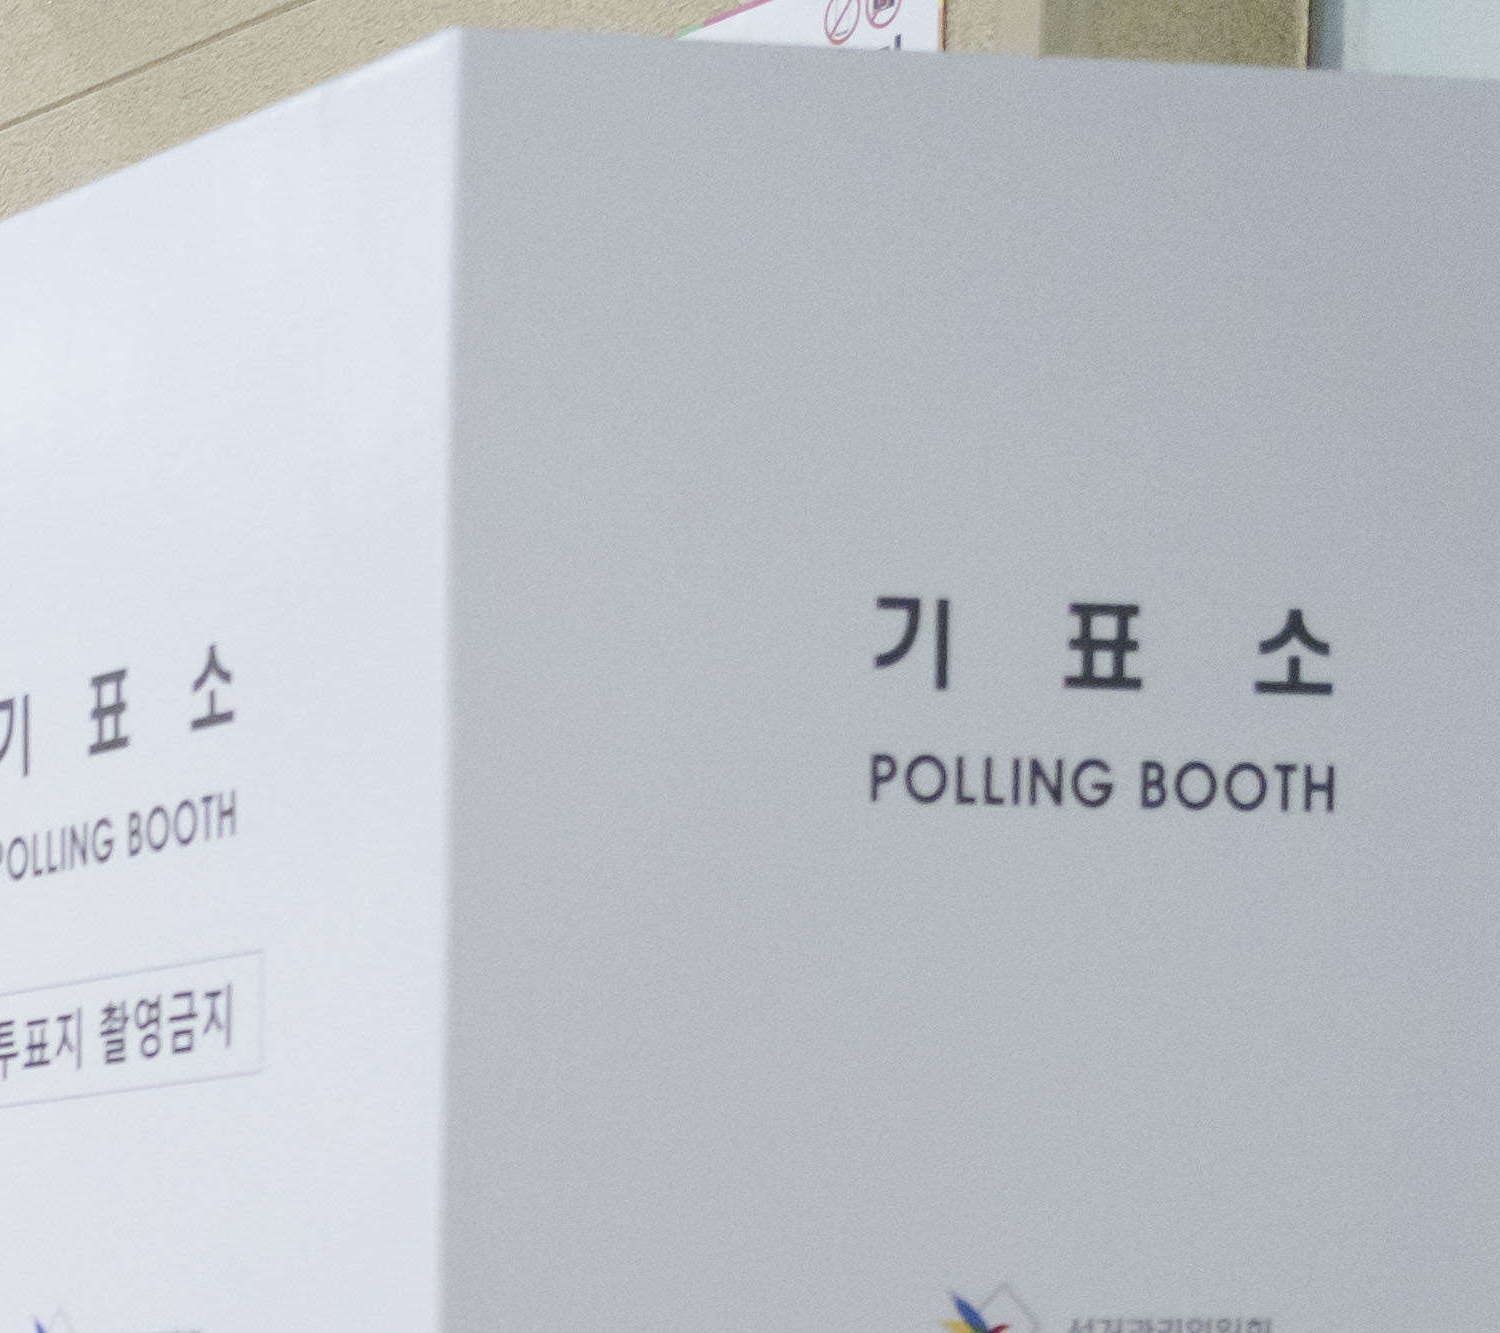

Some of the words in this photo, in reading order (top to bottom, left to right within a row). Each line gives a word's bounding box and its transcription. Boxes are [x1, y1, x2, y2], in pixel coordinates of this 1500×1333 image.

[870, 754, 1113, 808] POLLING
[1140, 760, 1335, 814] BOOTH
[128, 789, 236, 857] BOOTH
[100, 982, 232, 1065] 촬영금지
